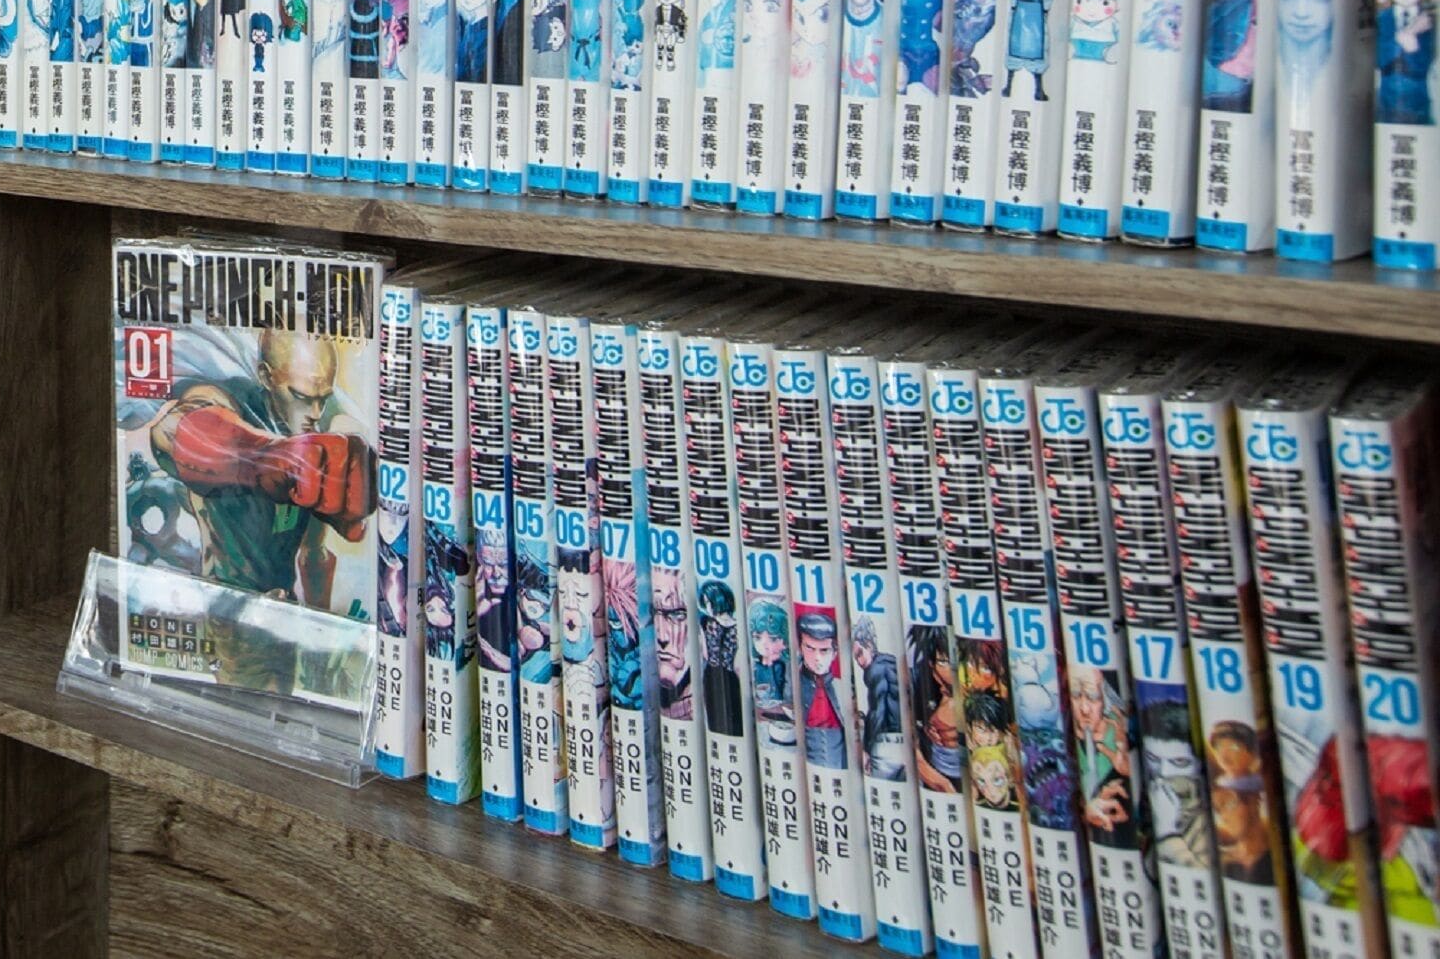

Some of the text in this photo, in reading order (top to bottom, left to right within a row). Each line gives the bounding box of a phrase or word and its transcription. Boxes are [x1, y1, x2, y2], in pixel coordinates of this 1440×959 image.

[128, 330, 168, 379] 01
[380, 465, 405, 500] 02
[423, 484, 450, 520] 03
[474, 492, 505, 529] 04
[515, 500, 543, 537] 05
[556, 510, 584, 548] 06
[602, 521, 629, 562] 07
[649, 529, 680, 567] 08
[694, 539, 729, 578] 09
[746, 553, 779, 591] 10
[796, 565, 824, 603] 11
[852, 572, 884, 613] 12
[904, 581, 938, 623] 13
[957, 594, 994, 637] 14
[1008, 608, 1046, 651] 15
[1069, 622, 1109, 666] 16
[165, 652, 203, 671] COMICS
[1135, 634, 1173, 680] 17
[1199, 647, 1242, 693] 18
[390, 667, 402, 711] ONE
[1279, 663, 1322, 711] 19
[1365, 675, 1420, 725] 20
[440, 691, 452, 735] ONE
[496, 704, 508, 749] ONE
[536, 716, 548, 762] ONE
[580, 728, 593, 776] ONE
[627, 744, 640, 792] ONE
[678, 754, 692, 804] ONE
[728, 772, 742, 822] ONE
[782, 789, 798, 840] ONE
[832, 805, 849, 858] ONE
[891, 820, 908, 872] ONE
[947, 832, 965, 886] ONE
[1004, 852, 1023, 908] ONE
[1058, 872, 1078, 929] ONE
